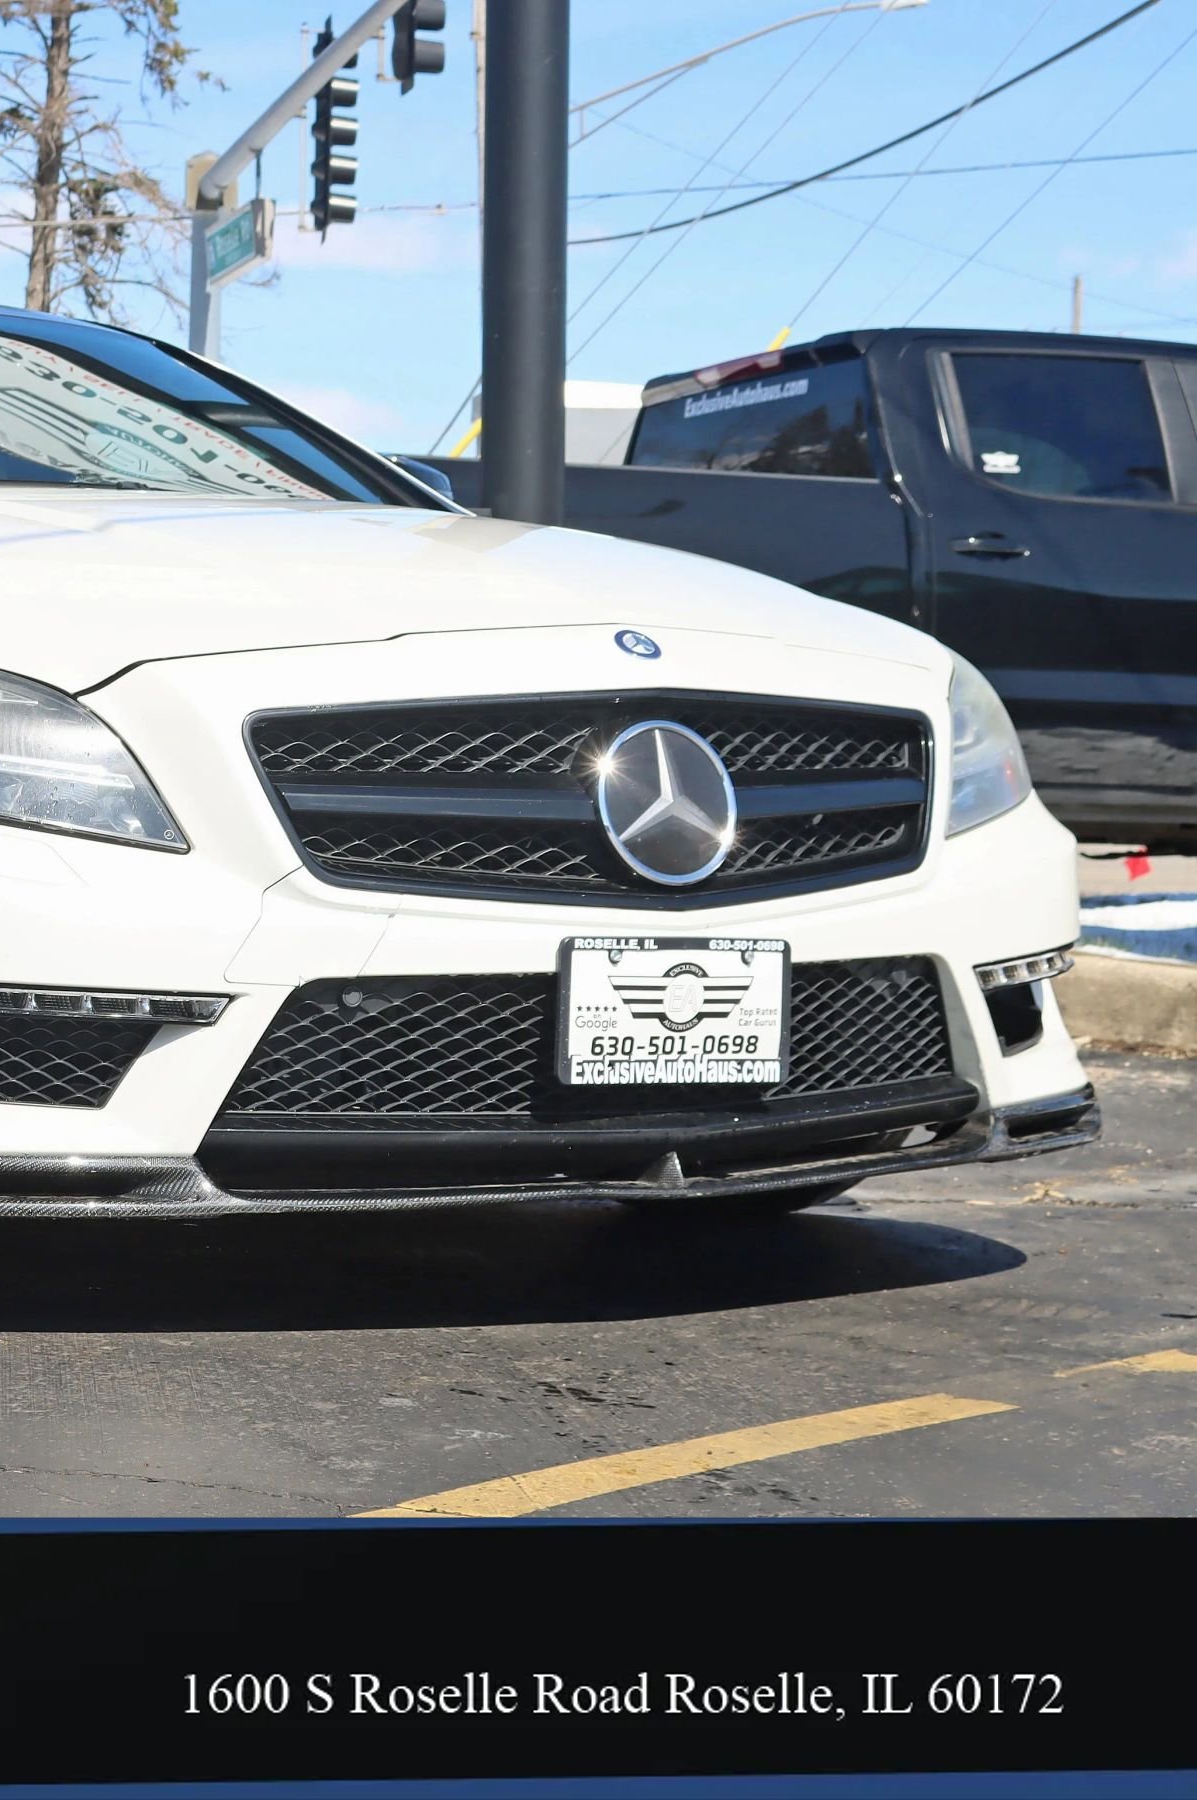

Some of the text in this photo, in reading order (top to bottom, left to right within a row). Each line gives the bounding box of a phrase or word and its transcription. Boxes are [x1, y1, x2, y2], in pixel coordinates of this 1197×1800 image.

[574, 938, 659, 950] ROSELLE, IL
[708, 939, 786, 952] 630-501-0698
[739, 1007, 754, 1017] Top
[574, 1015, 618, 1032] Google
[738, 1018, 752, 1027] Car
[591, 1035, 759, 1056] 630-501-0698
[570, 1055, 781, 1085] ExclusiveAutoHaus.com
